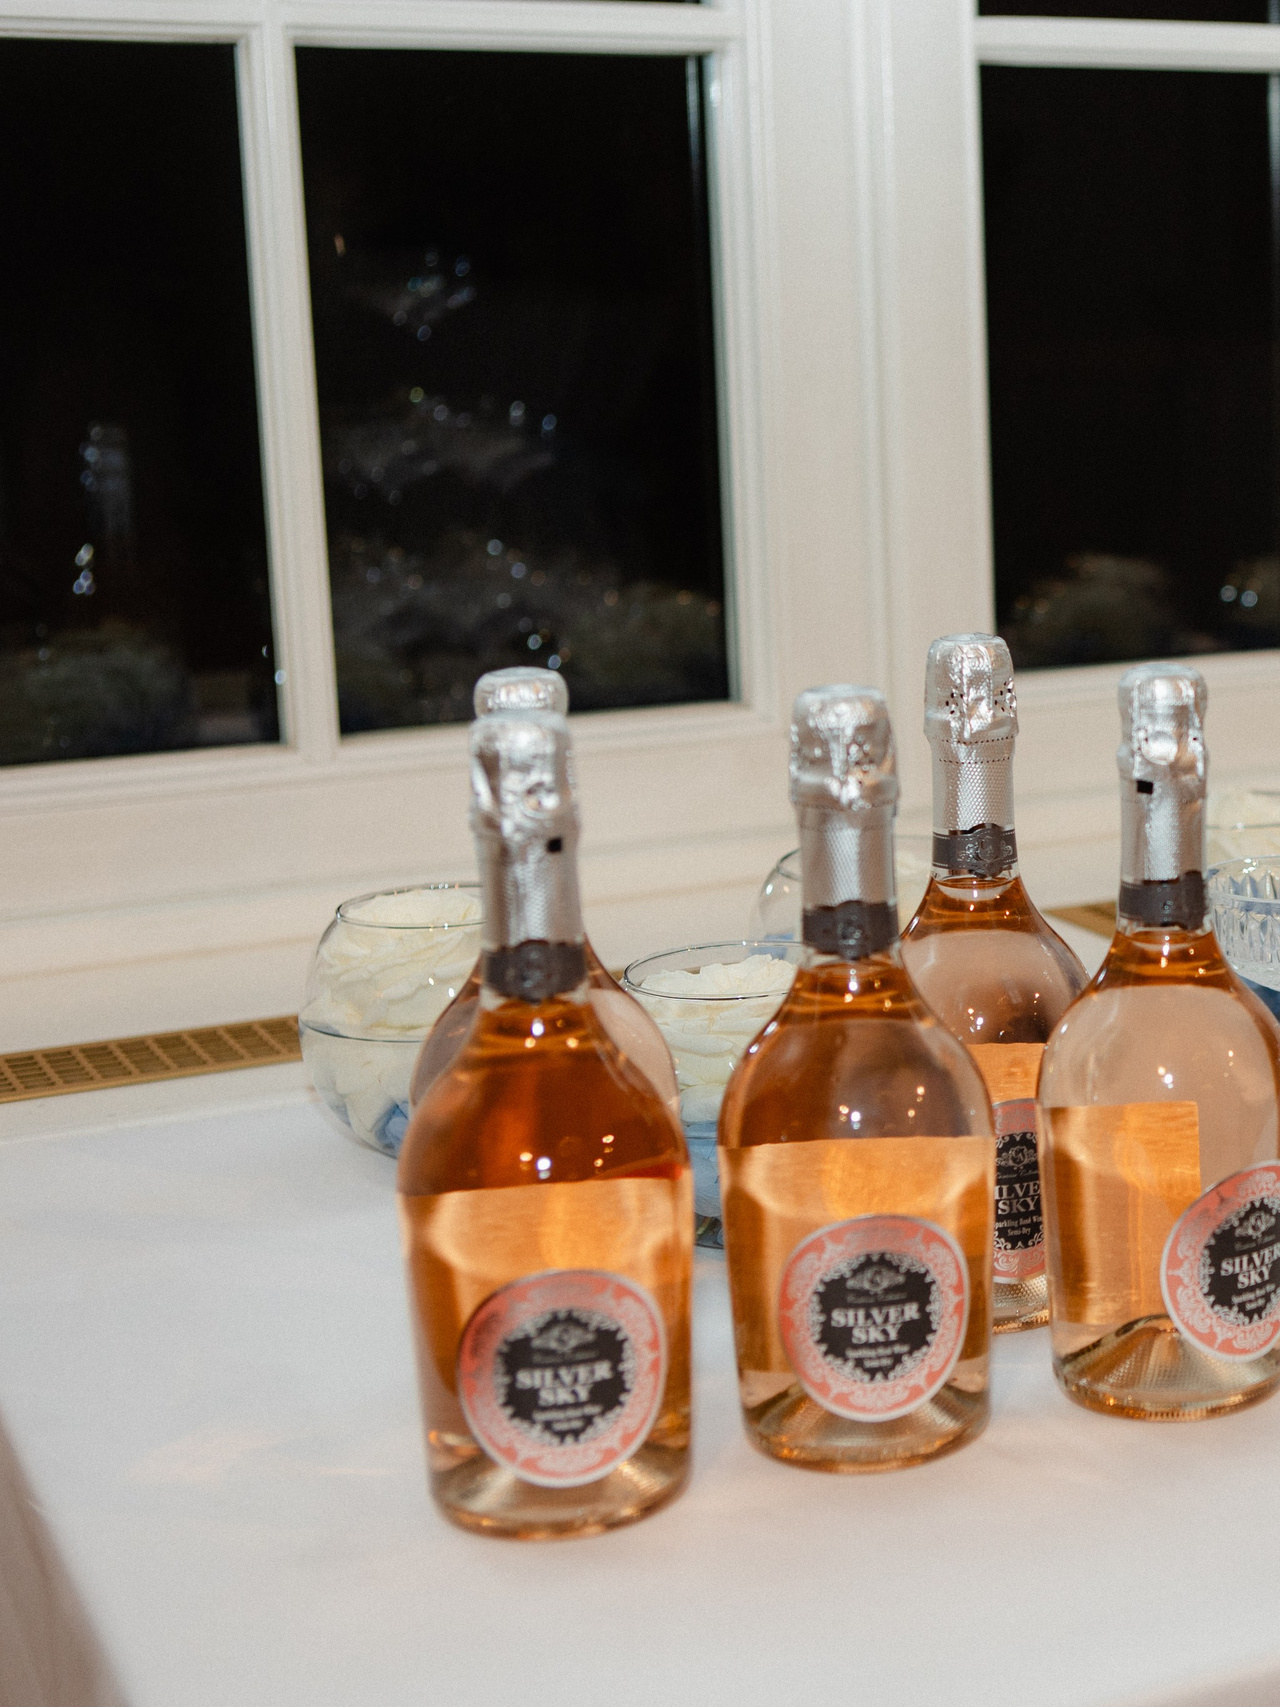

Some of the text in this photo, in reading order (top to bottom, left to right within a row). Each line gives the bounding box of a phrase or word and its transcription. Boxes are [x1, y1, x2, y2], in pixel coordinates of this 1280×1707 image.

[994, 1181, 1040, 1200] ILVE
[998, 1196, 1039, 1215] SKY
[995, 1219, 1018, 1230] parkling
[1237, 1263, 1273, 1289] SKY
[831, 1302, 920, 1327] SILVER
[851, 1322, 903, 1344] SKY
[515, 1360, 612, 1390] SILVER
[538, 1383, 594, 1407] SKY
